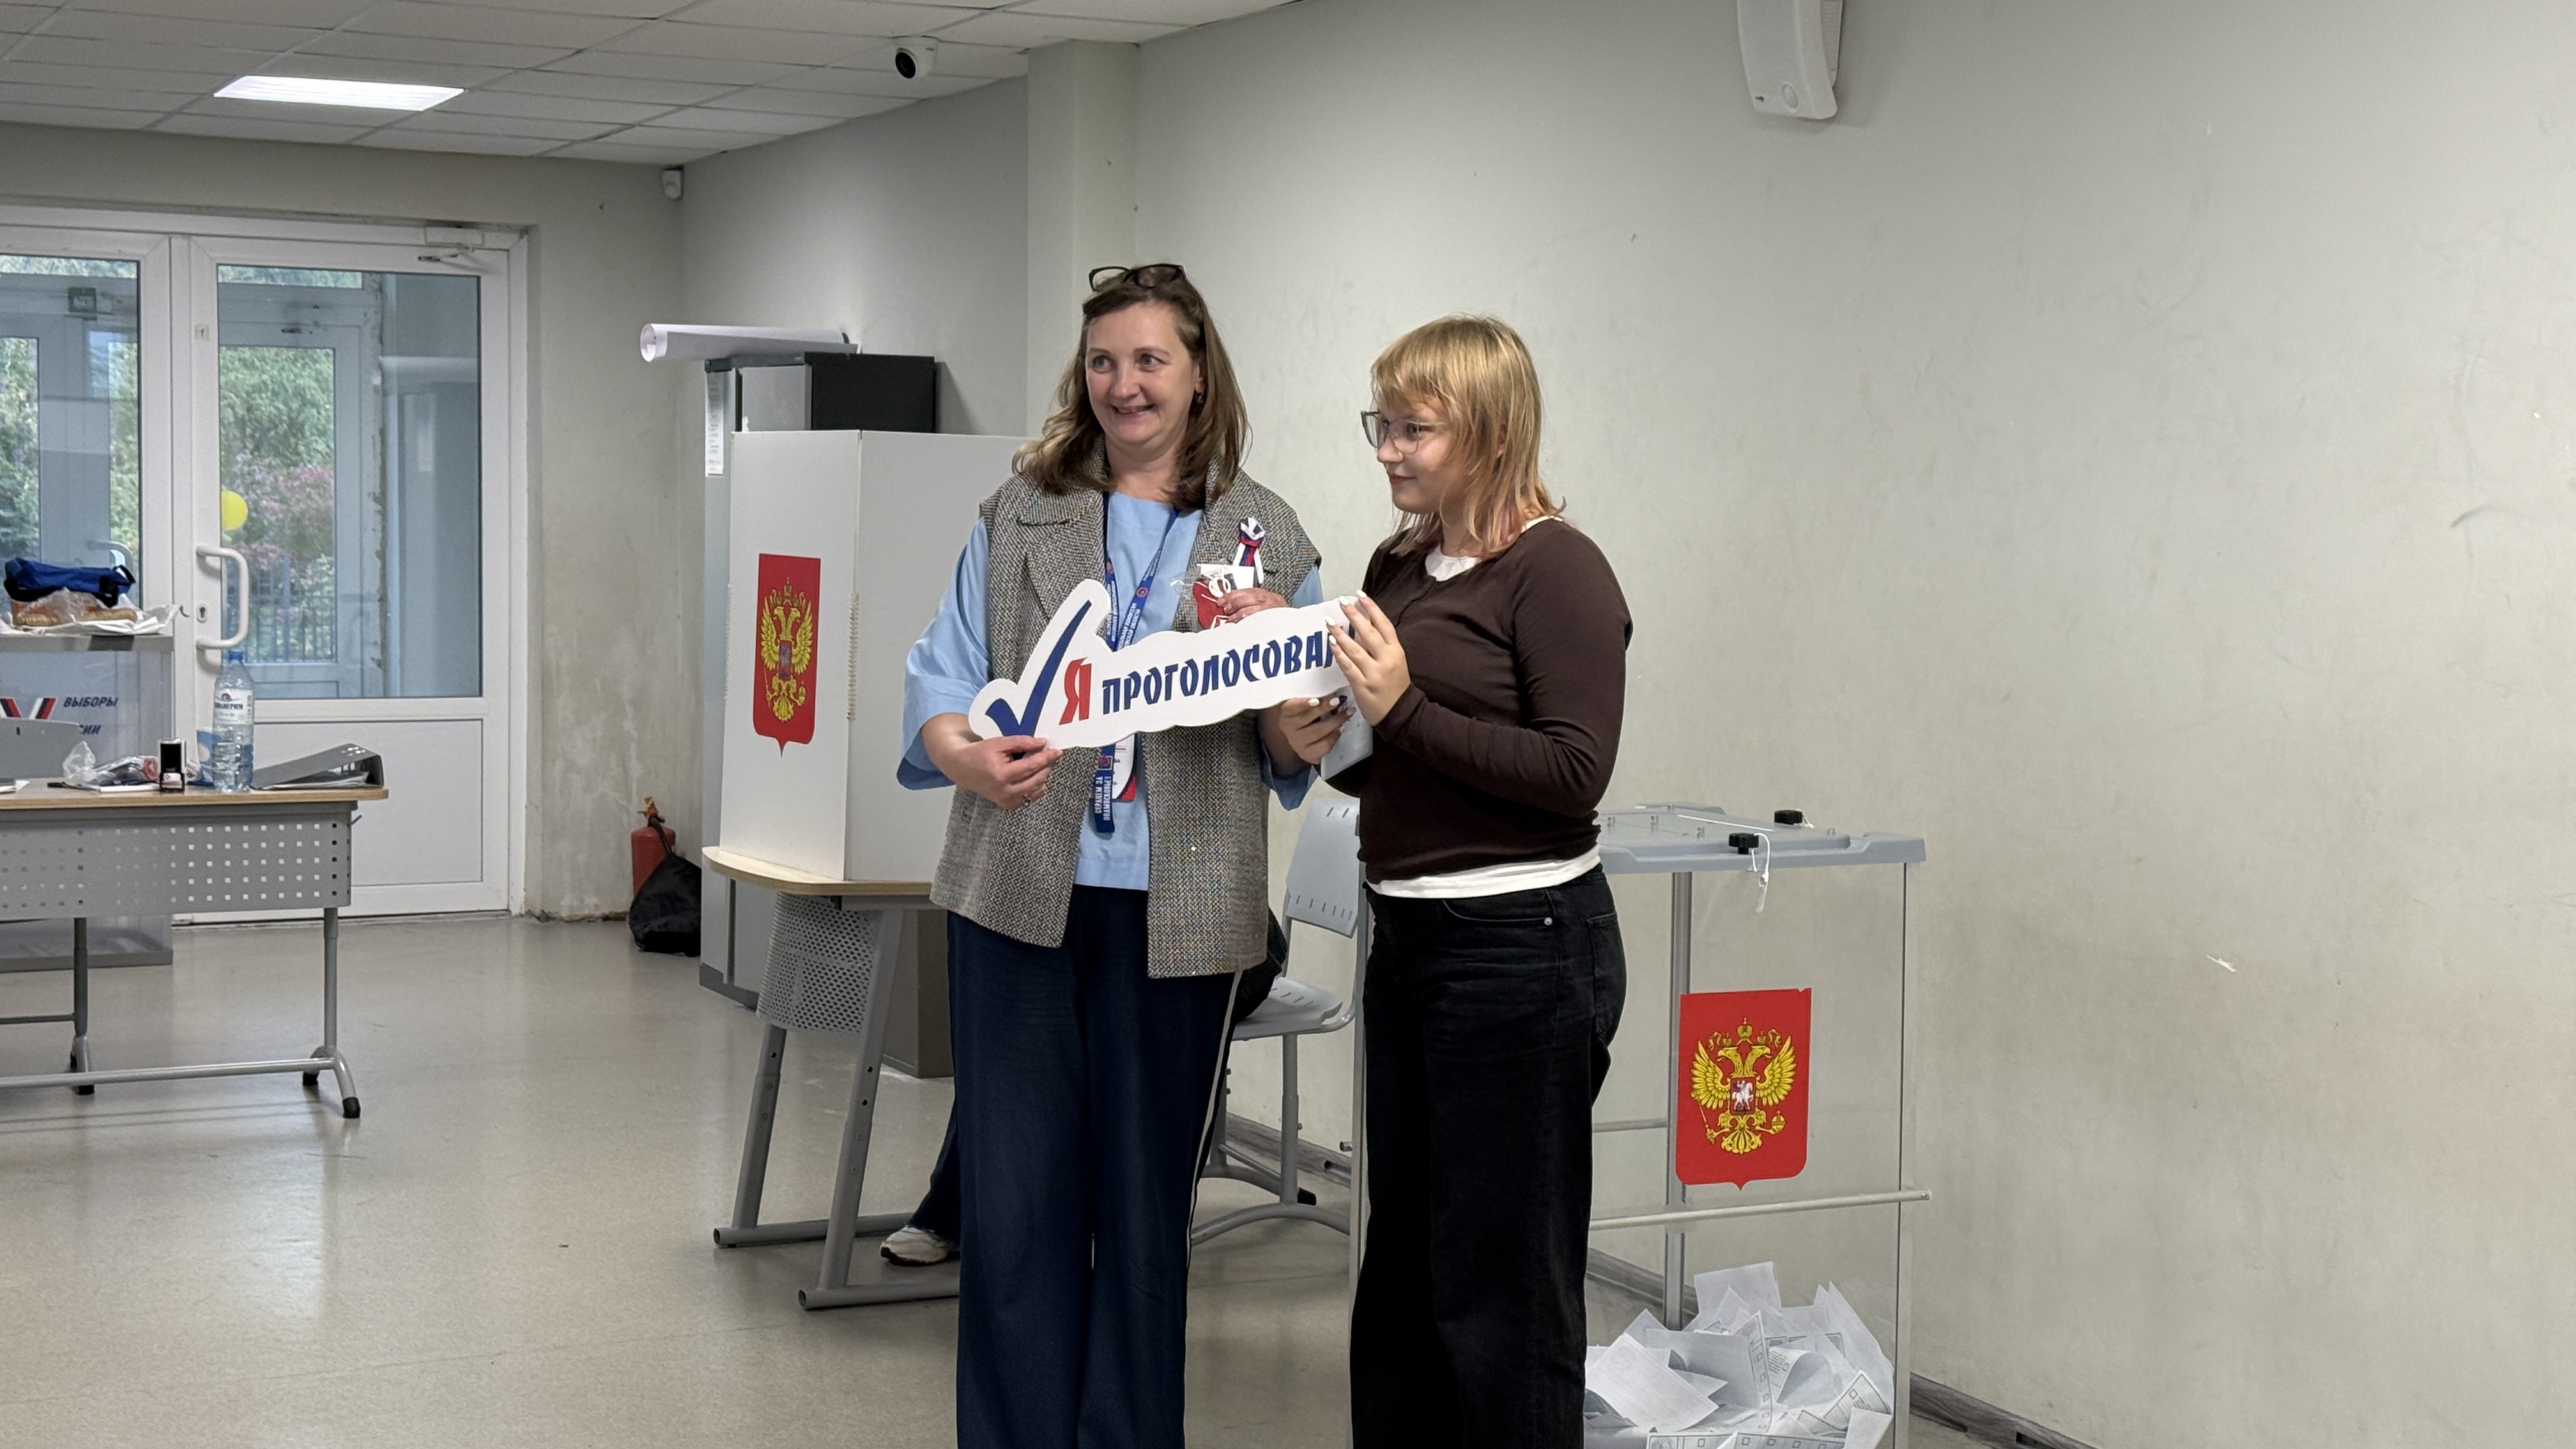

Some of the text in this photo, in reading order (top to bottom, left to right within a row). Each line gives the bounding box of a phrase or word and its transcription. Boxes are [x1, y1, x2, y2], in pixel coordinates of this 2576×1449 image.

[63, 696, 119, 707] ВЫБОРЫ
[1059, 622, 1355, 725] Я ПРОГОЛОСОВА
